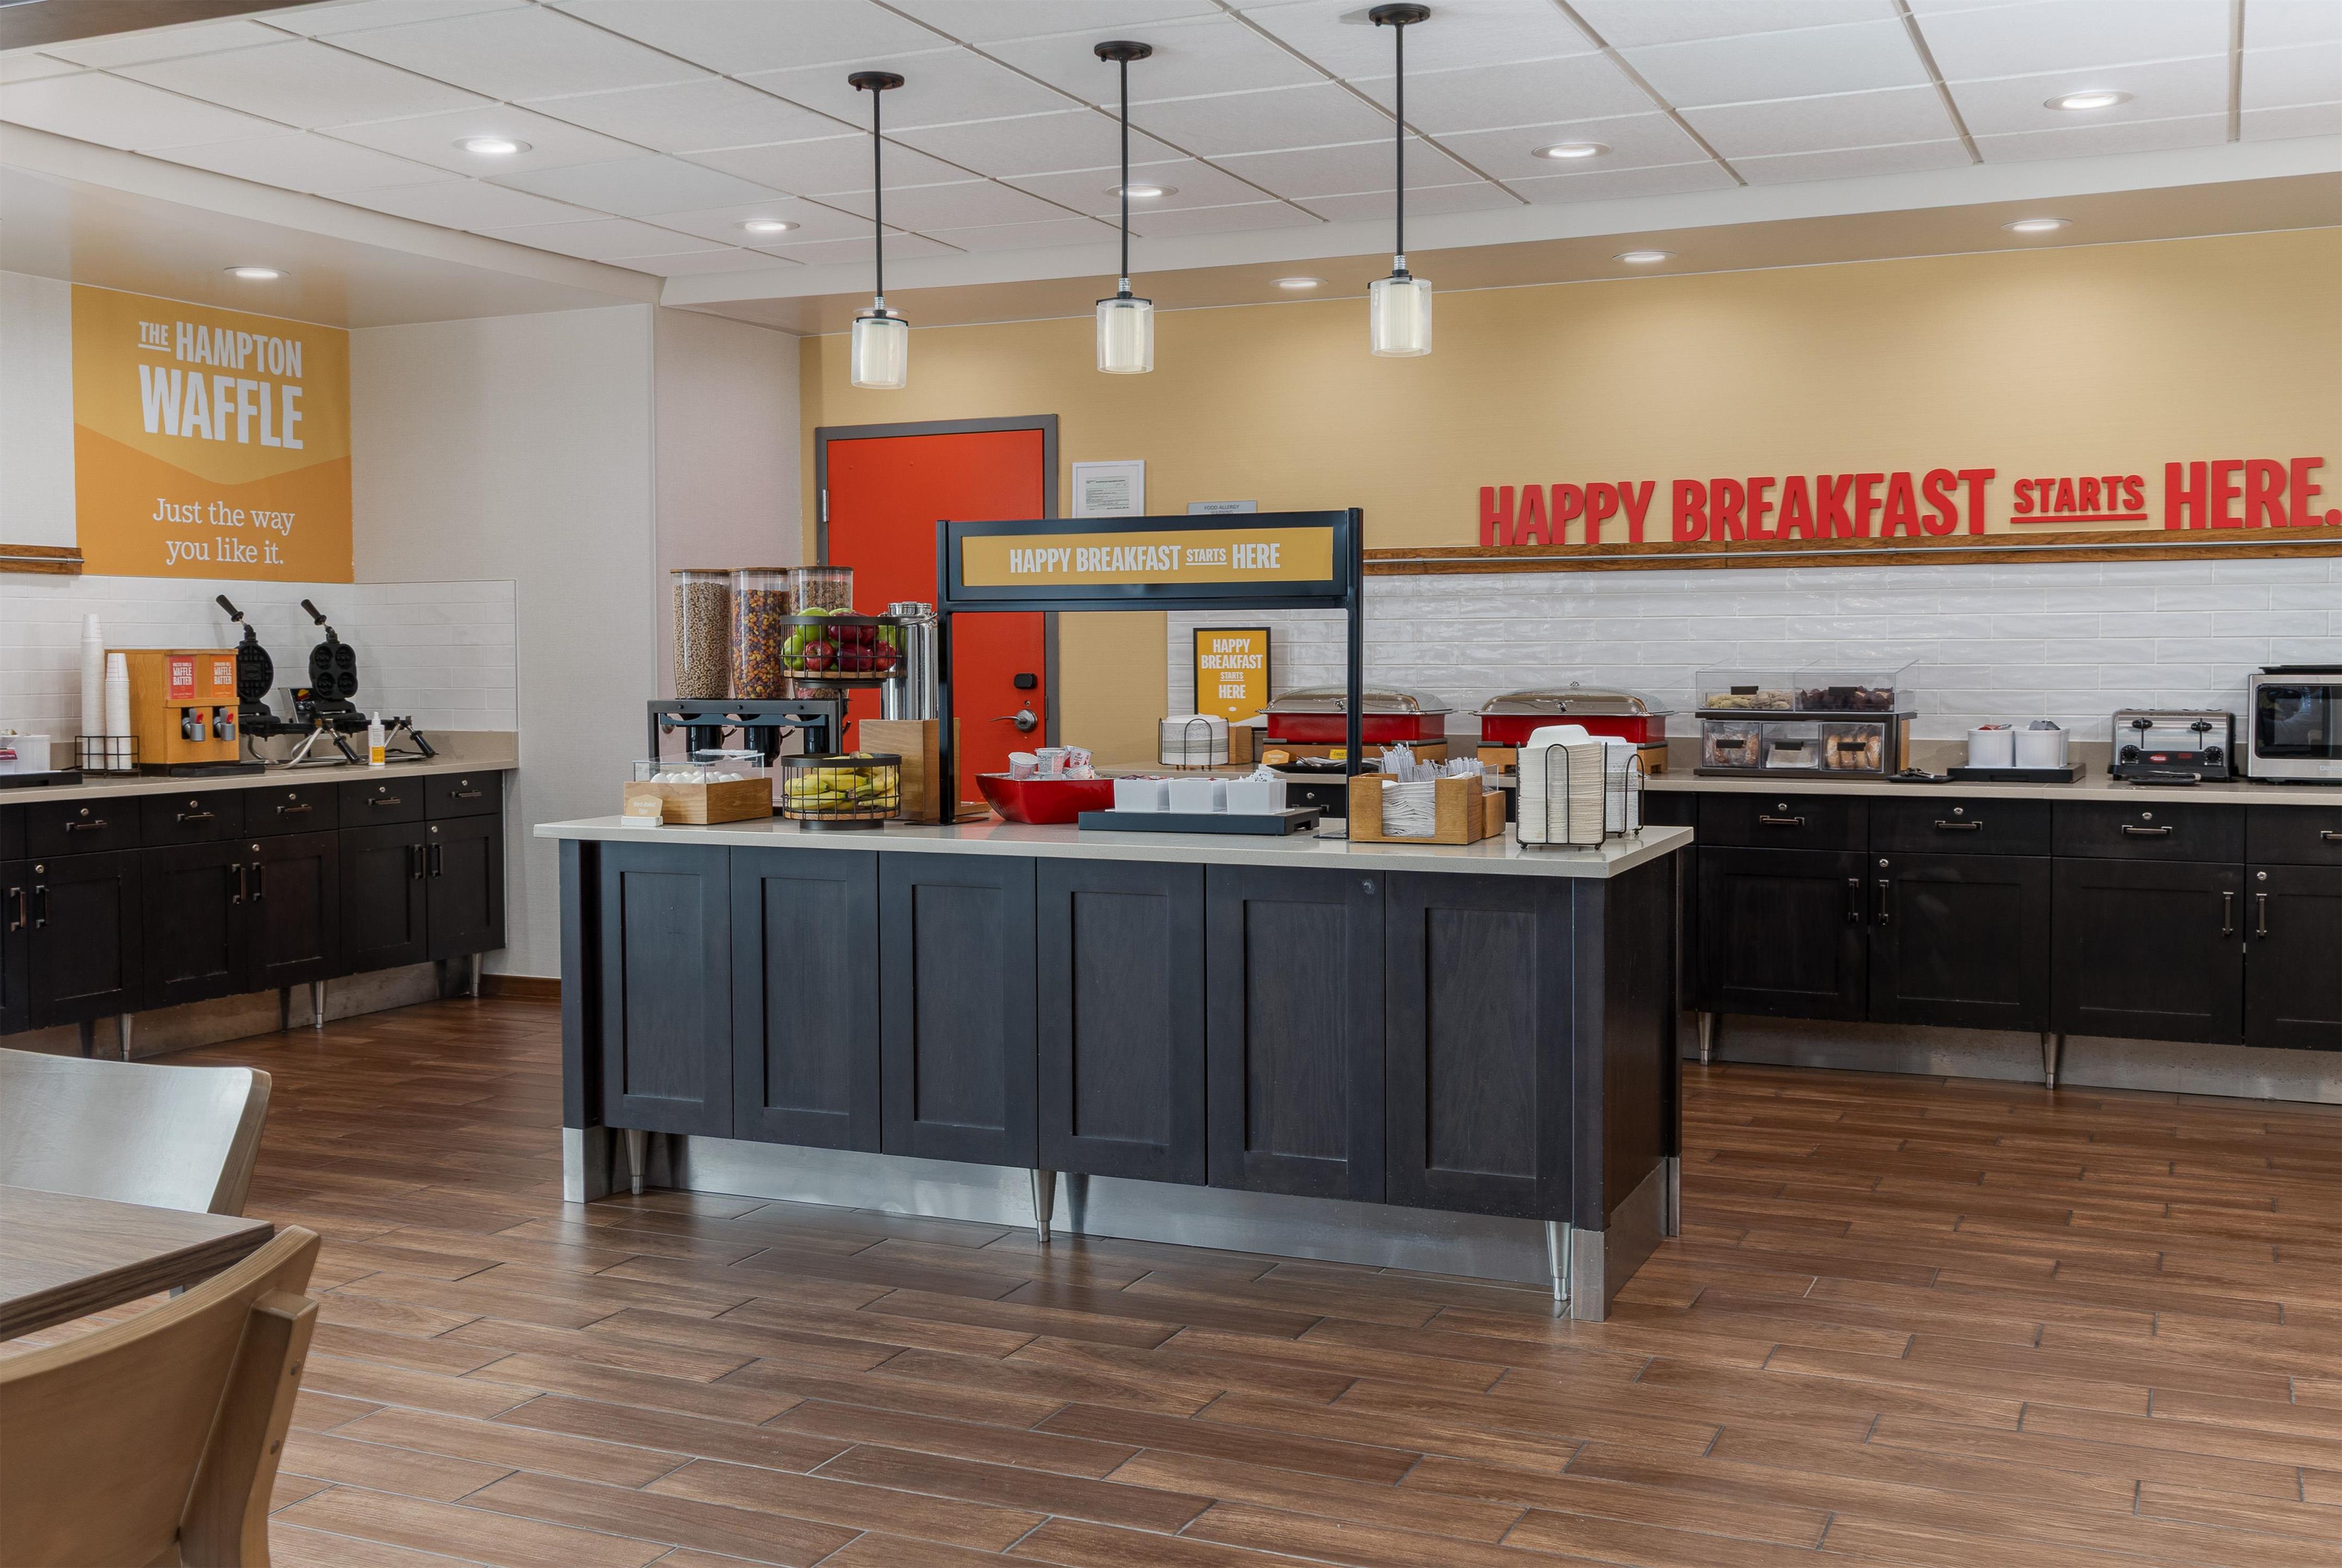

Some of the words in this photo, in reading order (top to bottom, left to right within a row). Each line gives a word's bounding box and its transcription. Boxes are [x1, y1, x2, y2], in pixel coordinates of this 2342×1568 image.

[139, 321, 169, 345] THE
[176, 321, 302, 378] HAMPTON
[138, 365, 303, 450] WAFFLE
[1480, 480, 1656, 546] HAPPY
[1672, 468, 1995, 542] BREAKFAST
[2014, 475, 2144, 513] STARTS
[2165, 457, 2341, 530] HERE.
[152, 498, 203, 523] Just
[209, 501, 245, 527] the
[250, 511, 296, 536] way
[165, 540, 210, 565] you
[216, 537, 258, 563] like
[263, 540, 284, 564] it.
[1010, 548, 1071, 573] HAPPY
[1076, 546, 1181, 572] BREAKFAST
[1186, 548, 1227, 562] STARTS
[1233, 543, 1281, 569] HERE
[1213, 639, 1250, 653] HAPPY
[1201, 654, 1263, 669] BREAKFAST
[173, 667, 192, 676] WAFFLE
[214, 666, 232, 676] WAFFLE
[173, 676, 192, 685] BATTER
[214, 676, 232, 685] BATTER
[1218, 684, 1246, 699] HERE
